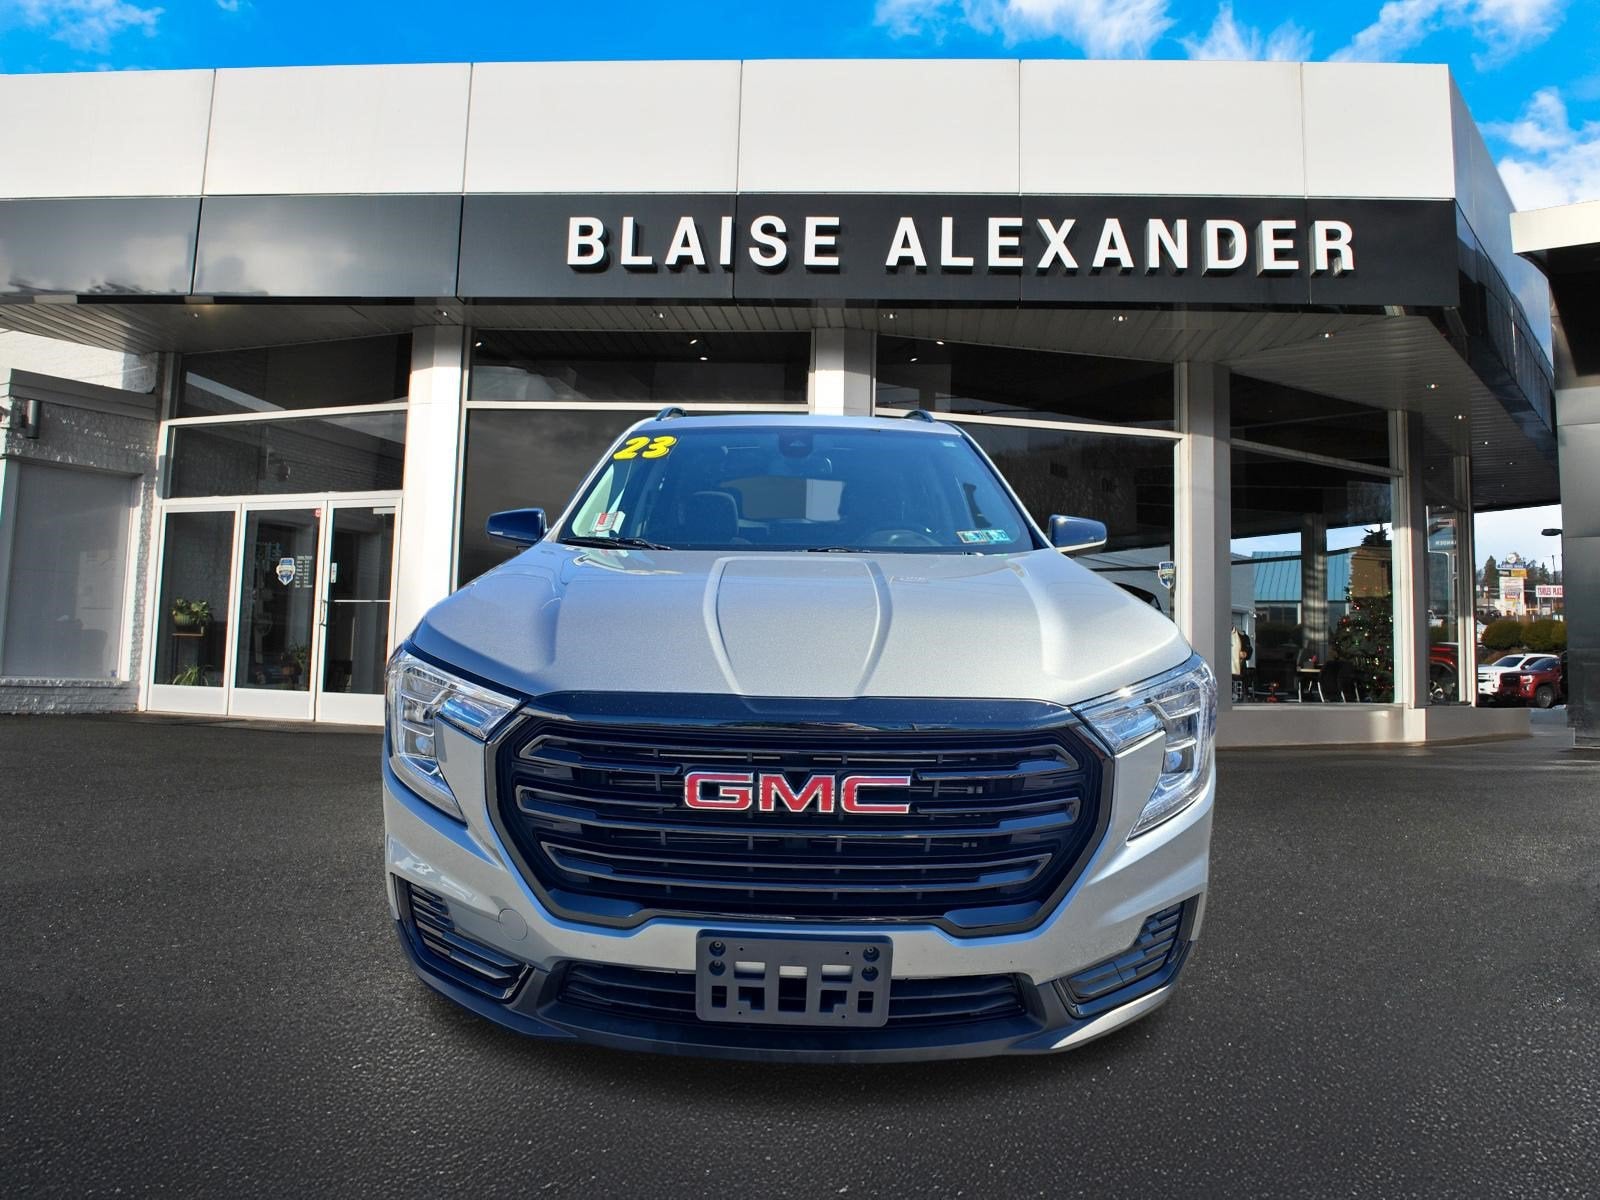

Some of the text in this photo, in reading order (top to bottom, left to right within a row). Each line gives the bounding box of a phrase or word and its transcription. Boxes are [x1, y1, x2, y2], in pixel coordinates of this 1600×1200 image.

[567, 215, 1355, 272] BLAISE ALEXANDER
[613, 435, 678, 460] 23
[684, 771, 911, 814] GMC
